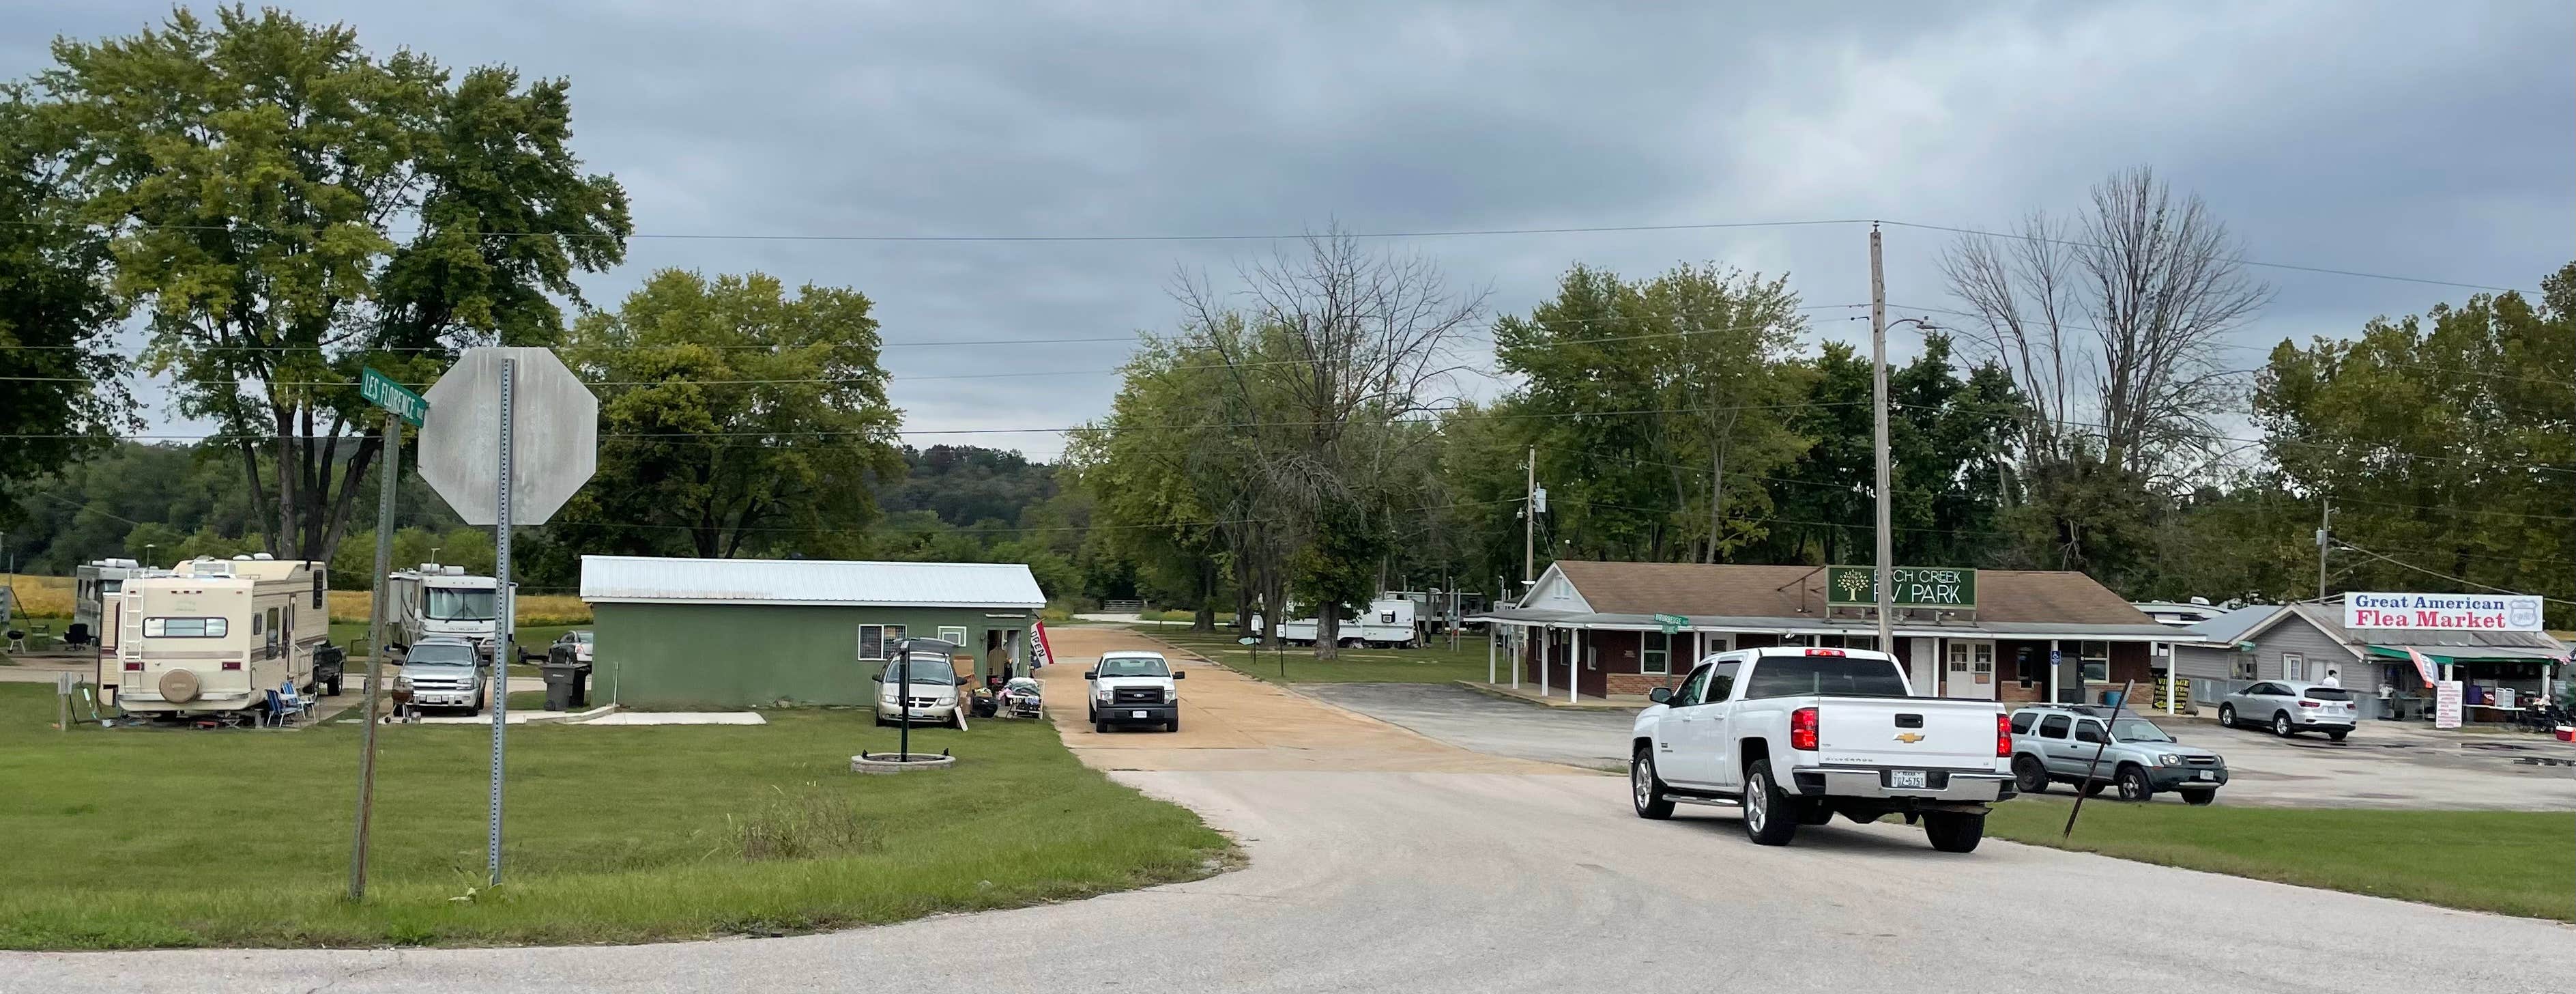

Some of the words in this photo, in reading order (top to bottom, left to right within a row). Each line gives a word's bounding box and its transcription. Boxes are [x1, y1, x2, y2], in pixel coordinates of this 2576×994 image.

[364, 373, 379, 401] LES
[380, 382, 416, 420] FLORENCE
[1919, 570, 1961, 584] CREEK
[1911, 584, 1961, 604] PARK
[2356, 595, 2409, 608] Great
[2414, 596, 2505, 610] American
[2356, 610, 2409, 627] Flea
[2416, 611, 2506, 628] Market
[1031, 631, 1045, 657] OPEN
[2158, 678, 2189, 686] VIAGE
